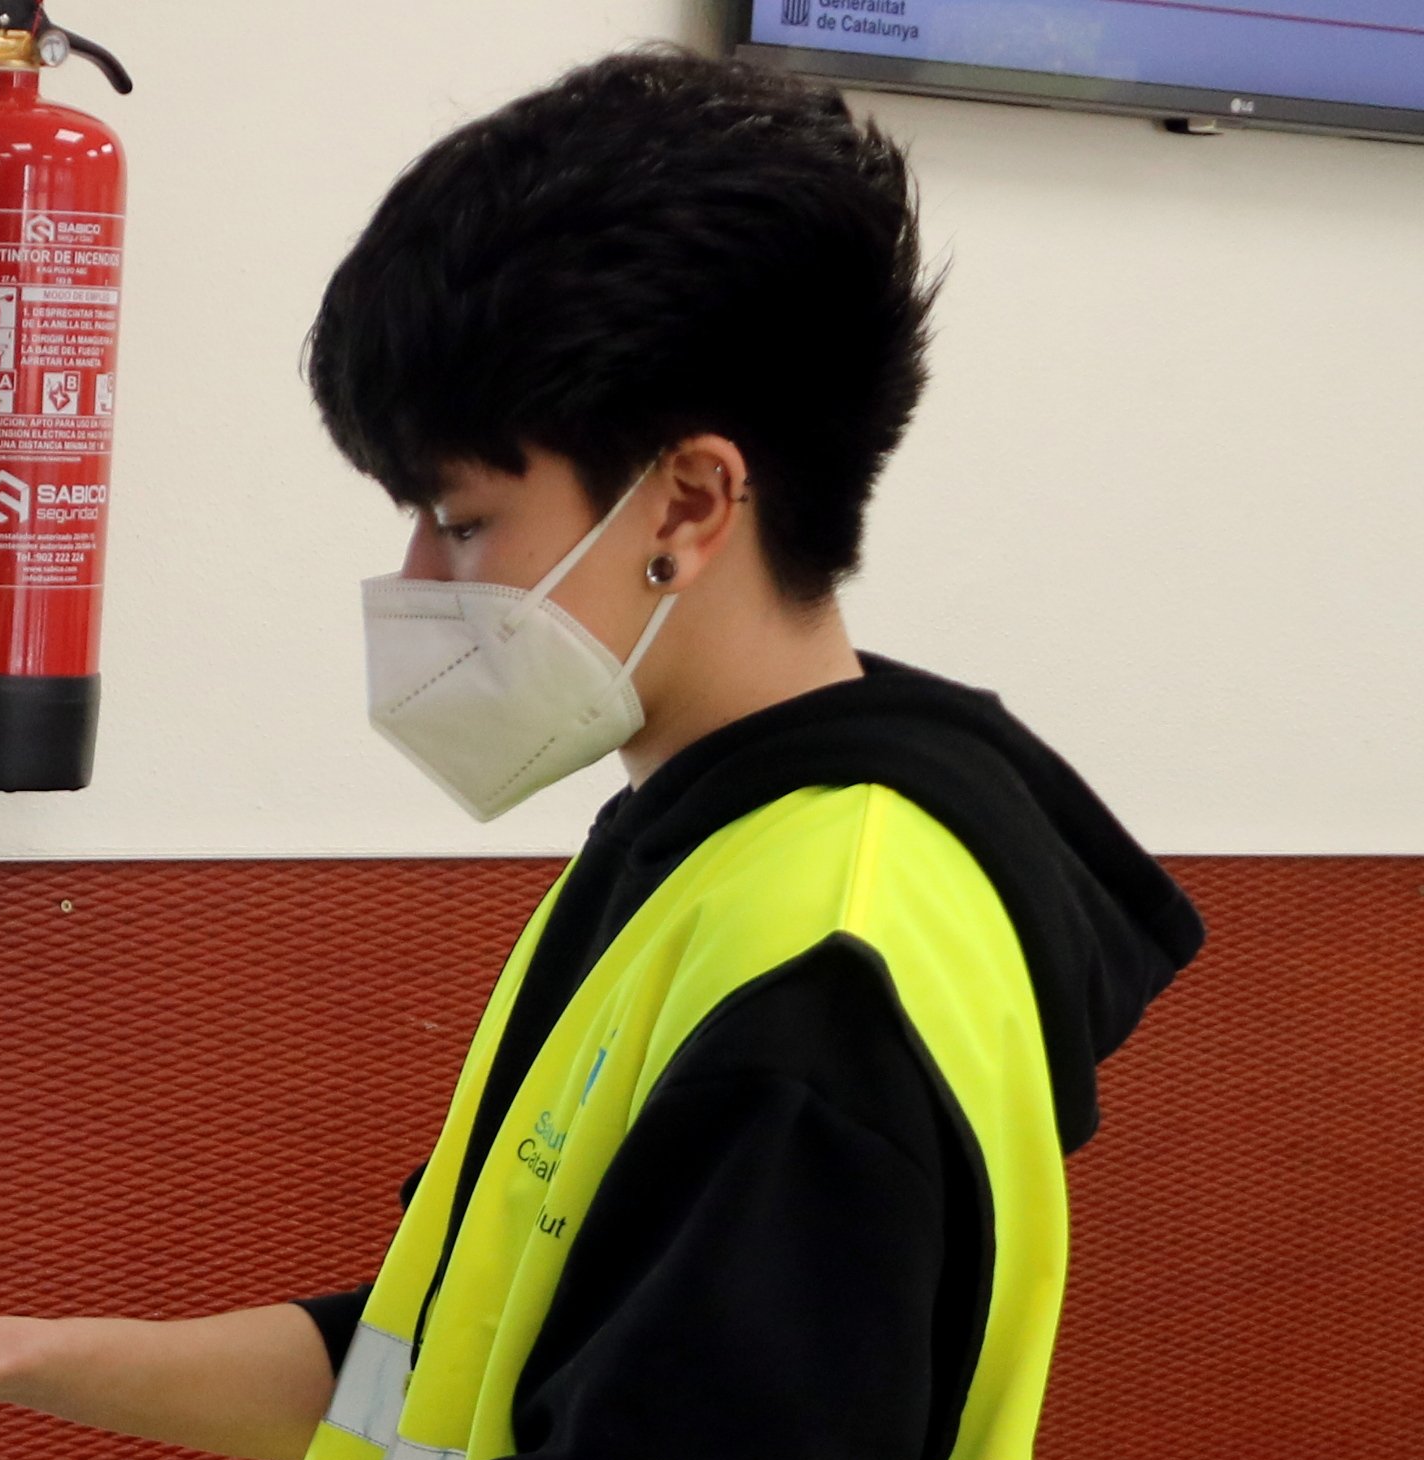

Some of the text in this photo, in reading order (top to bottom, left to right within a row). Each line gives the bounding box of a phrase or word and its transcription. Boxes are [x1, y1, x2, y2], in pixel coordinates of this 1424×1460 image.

[817, 13, 919, 42] de Catalunya
[55, 250, 71, 263] DE
[75, 251, 120, 266] INCENDIOS
[37, 320, 50, 328] LA
[51, 321, 79, 329] ANILLA
[0, 374, 12, 389] A
[67, 376, 77, 389] B
[18, 441, 62, 450] DISTANCIA
[37, 484, 107, 504] SABICO
[37, 507, 99, 523] seguridad
[55, 552, 70, 562] 222
